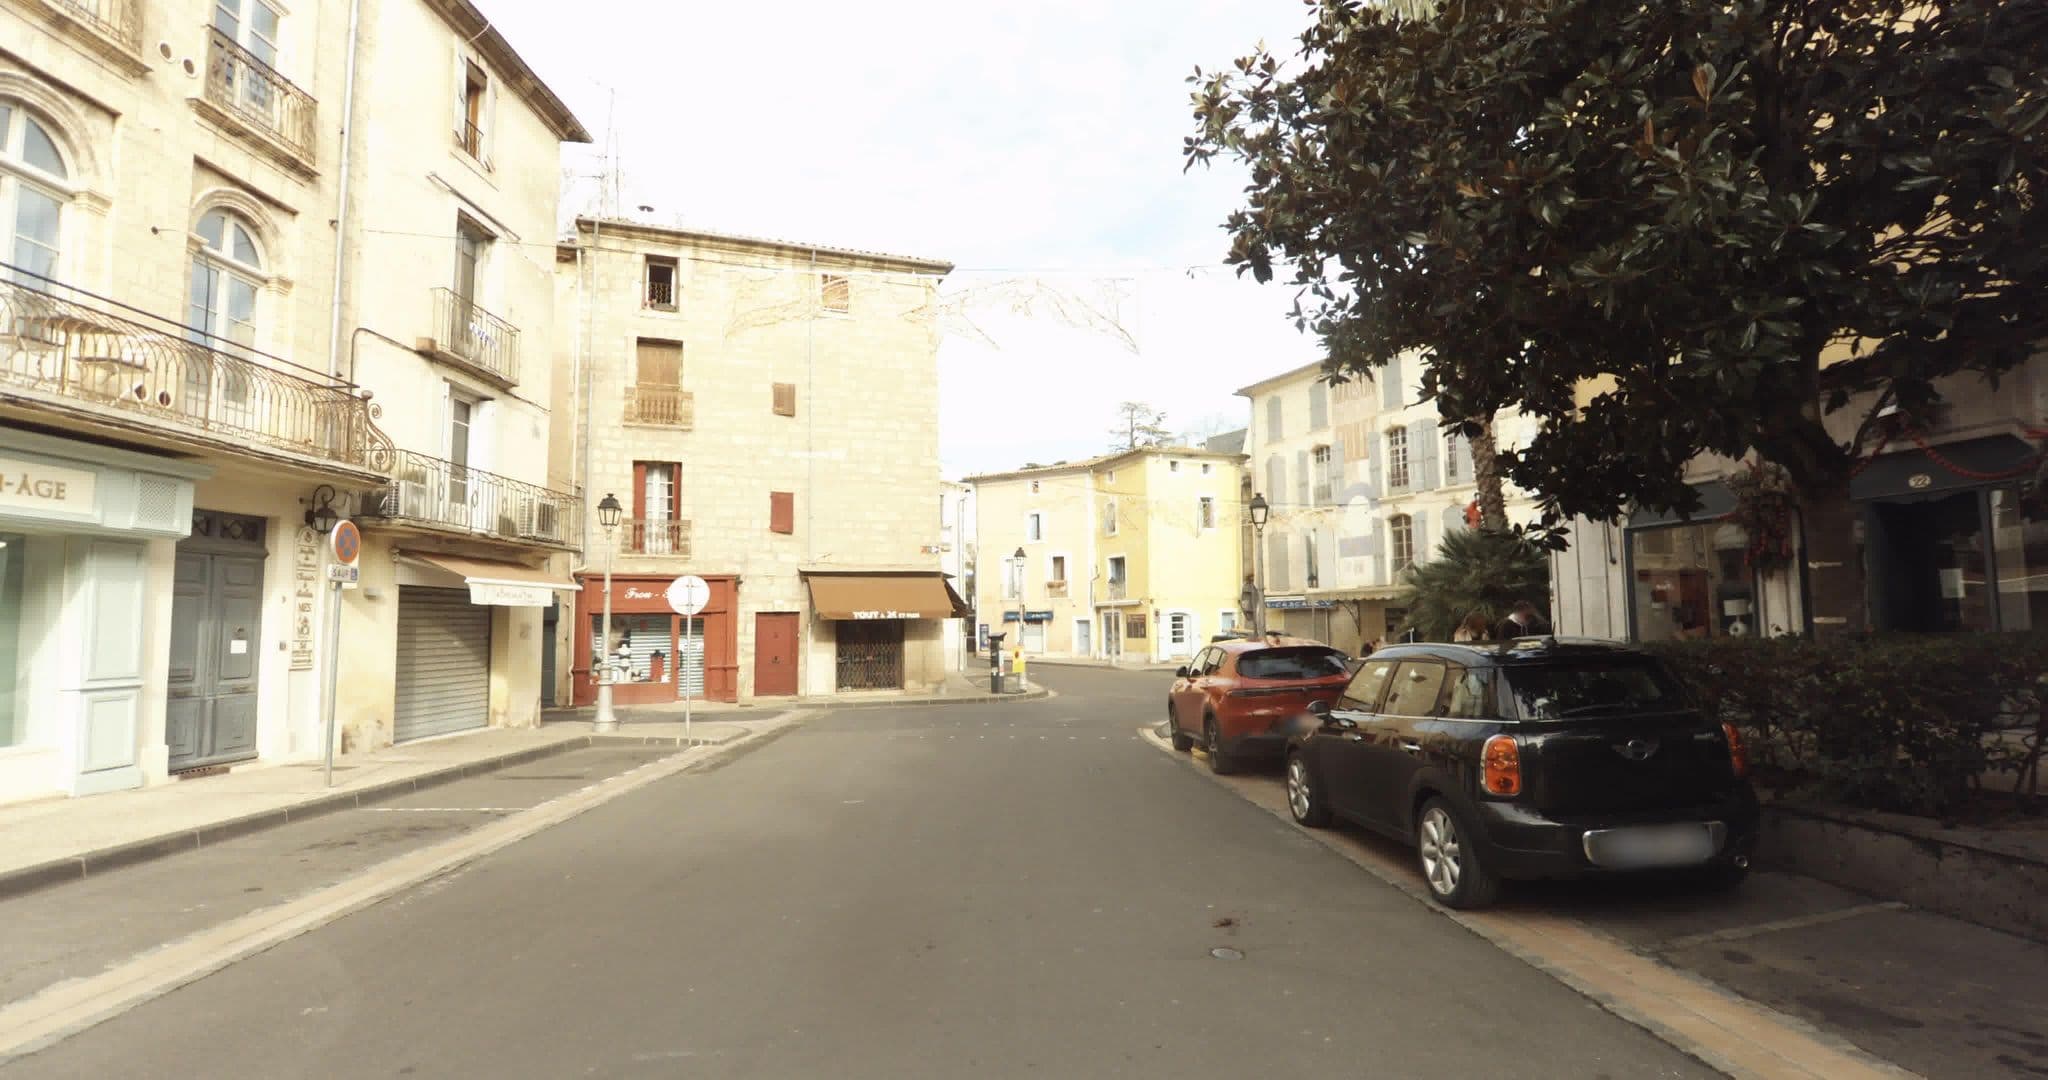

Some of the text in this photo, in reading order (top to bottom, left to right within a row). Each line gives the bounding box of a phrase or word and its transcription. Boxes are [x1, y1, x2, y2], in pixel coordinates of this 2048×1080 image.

[0, 472, 66, 500] -ÂGE
[331, 567, 350, 577] SAUF
[852, 611, 879, 620] TOUT
